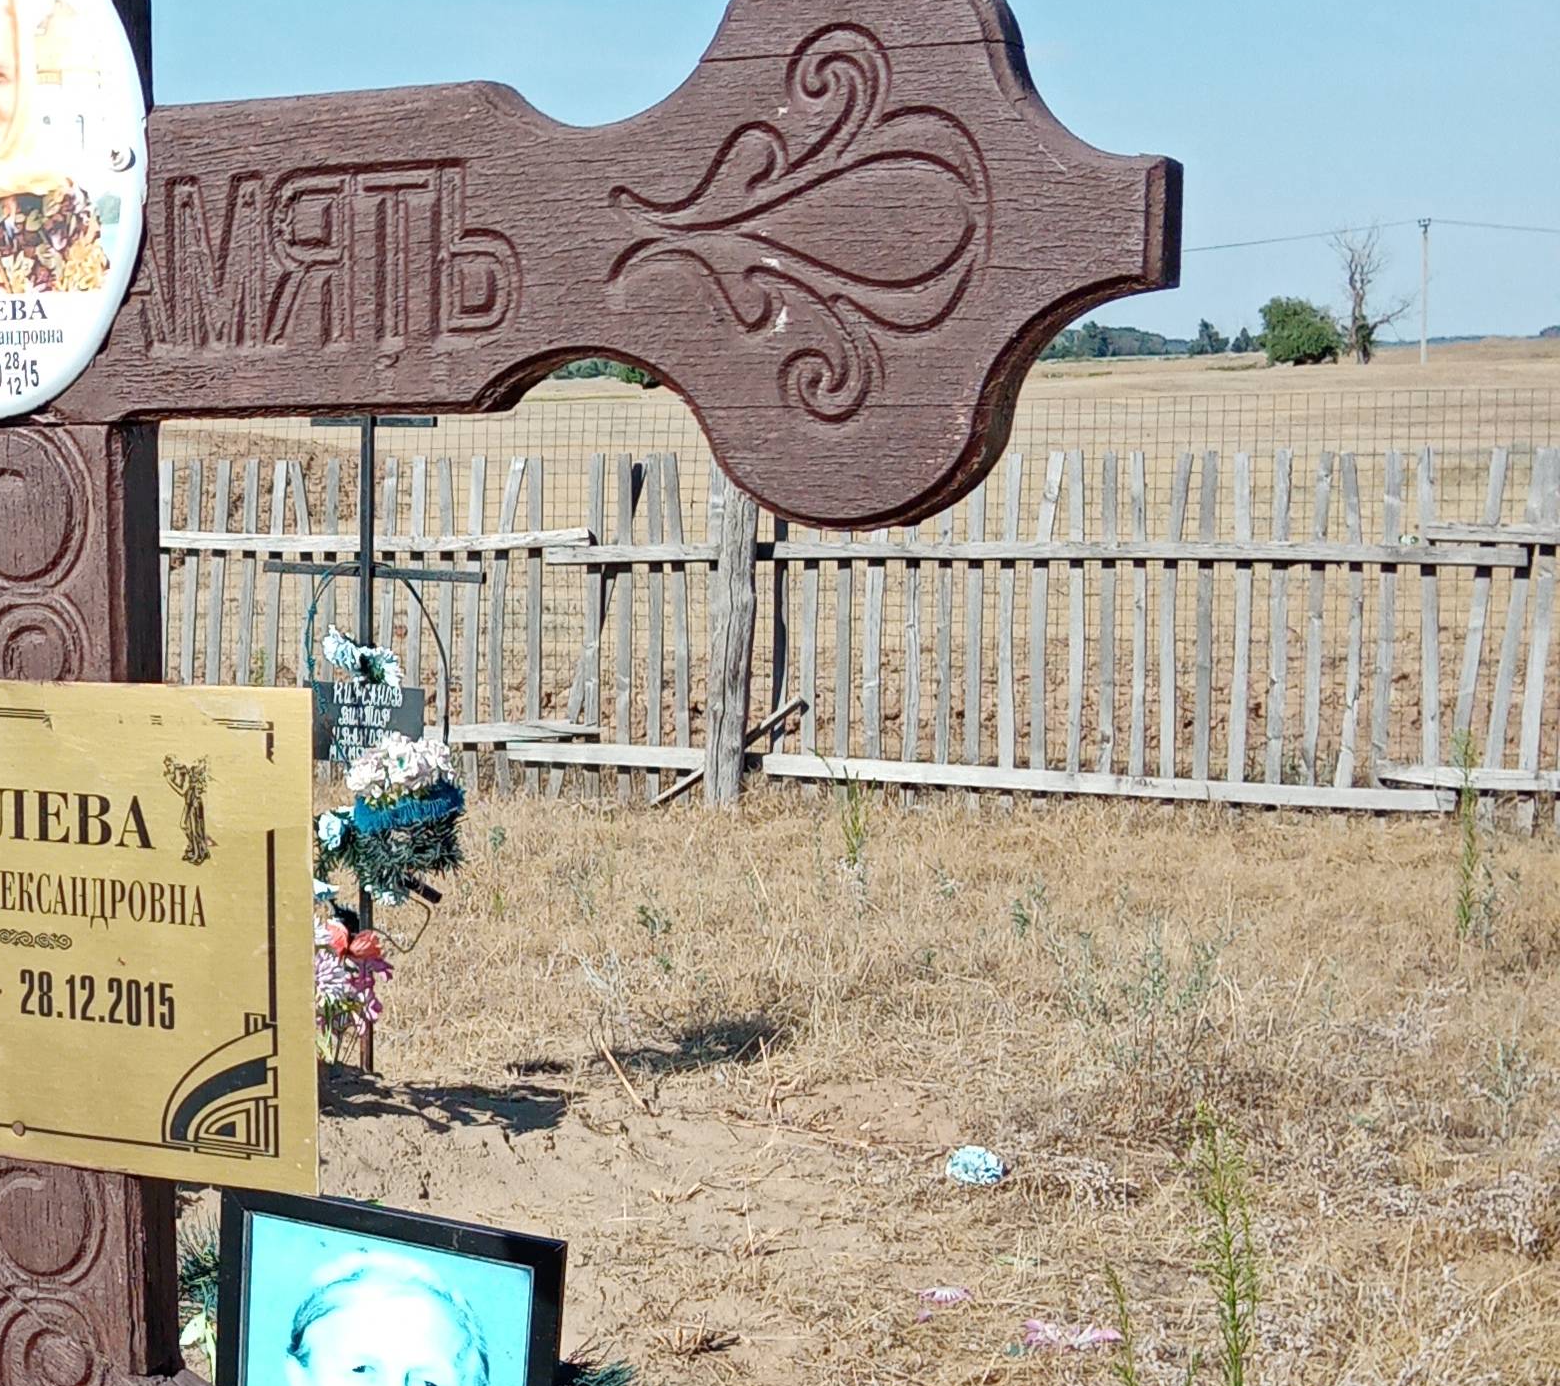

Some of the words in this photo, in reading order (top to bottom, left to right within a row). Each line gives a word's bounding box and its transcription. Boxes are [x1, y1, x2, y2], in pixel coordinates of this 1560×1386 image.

[137, 158, 522, 348] МЯТЬ
[332, 726, 393, 749] ИВАНОВ
[20, 969, 175, 1030] 28.12.2015
